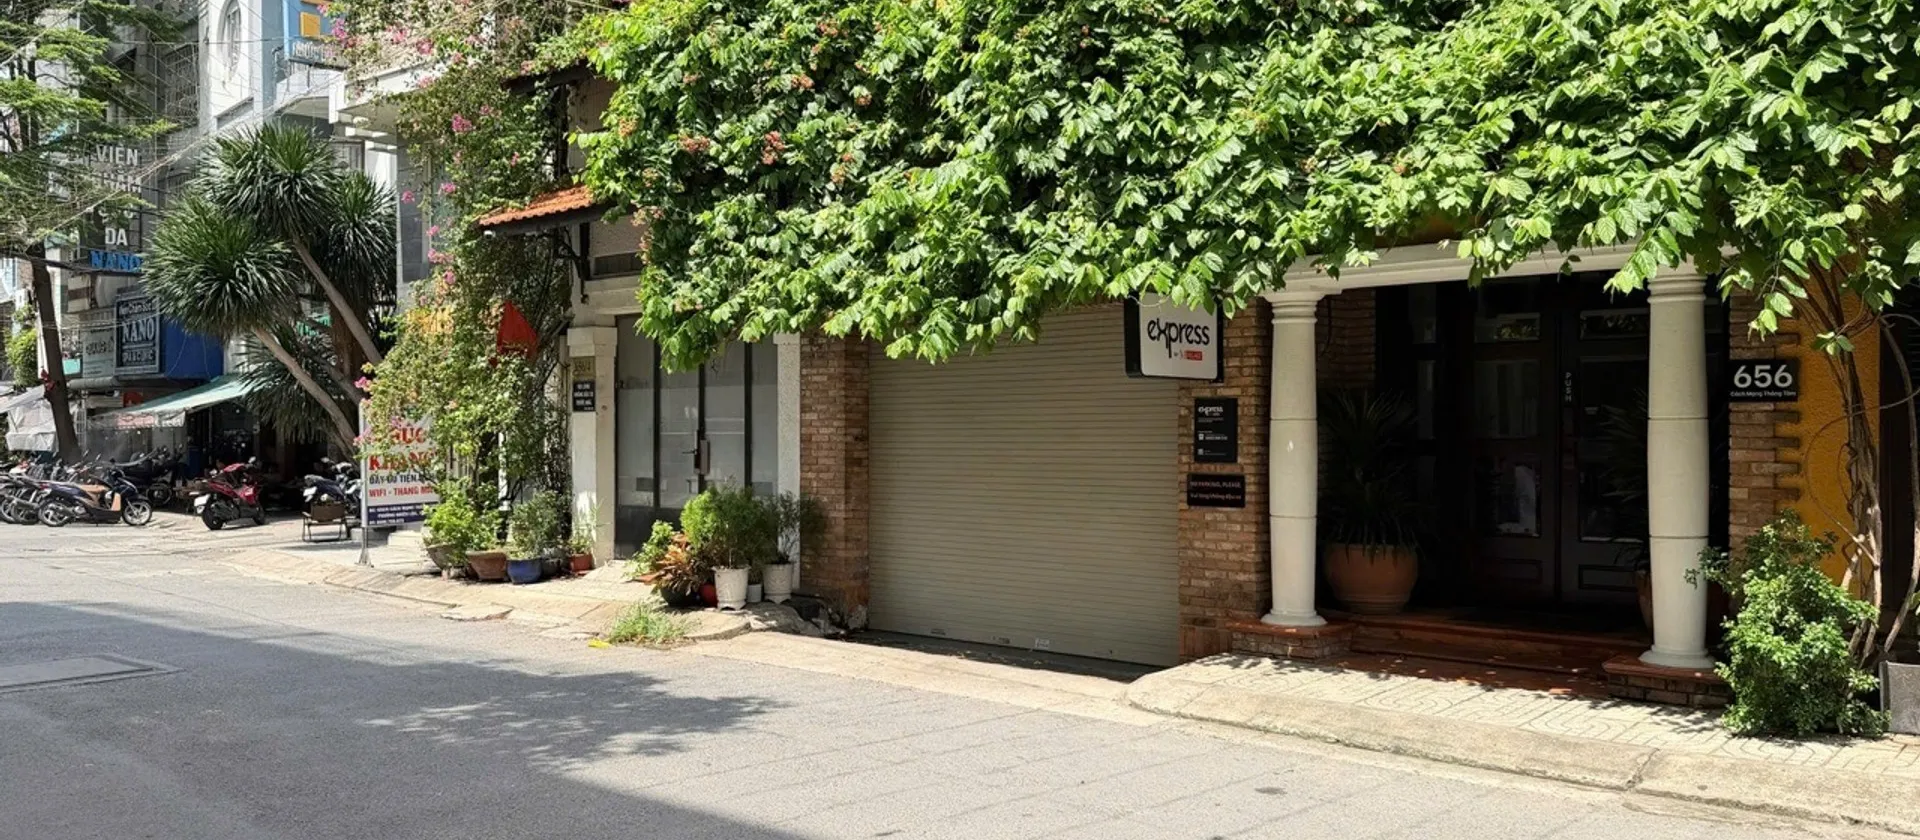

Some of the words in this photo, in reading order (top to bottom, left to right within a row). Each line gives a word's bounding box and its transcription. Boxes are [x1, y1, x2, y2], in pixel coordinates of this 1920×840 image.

[105, 228, 128, 246] DA
[90, 250, 142, 272] NANO
[122, 318, 155, 343] NANO
[1147, 318, 1210, 358] express
[1564, 371, 1572, 403] PUSH
[1734, 364, 1793, 388] 656
[369, 488, 387, 497] WIFI
